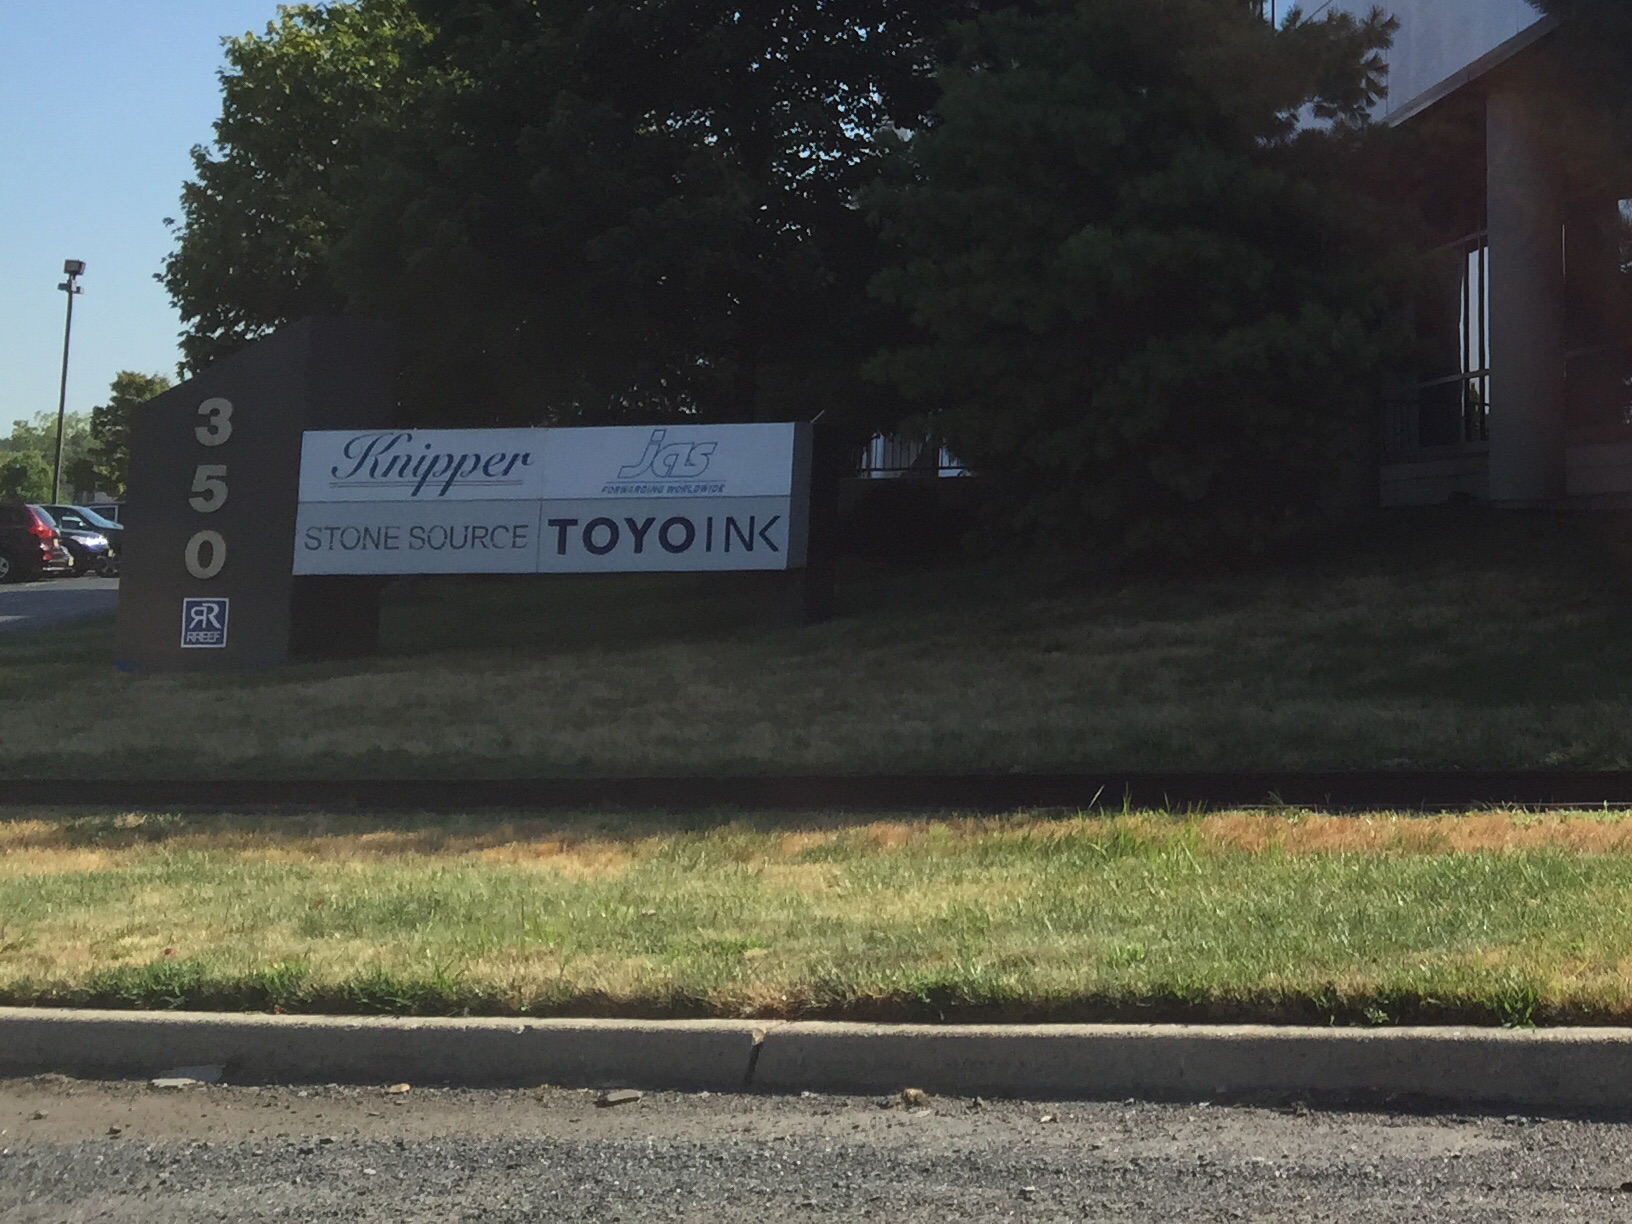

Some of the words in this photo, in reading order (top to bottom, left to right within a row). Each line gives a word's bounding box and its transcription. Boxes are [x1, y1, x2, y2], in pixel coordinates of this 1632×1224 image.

[331, 432, 535, 497] Knipper
[304, 526, 400, 551] STONE
[408, 525, 529, 550] SOURCE
